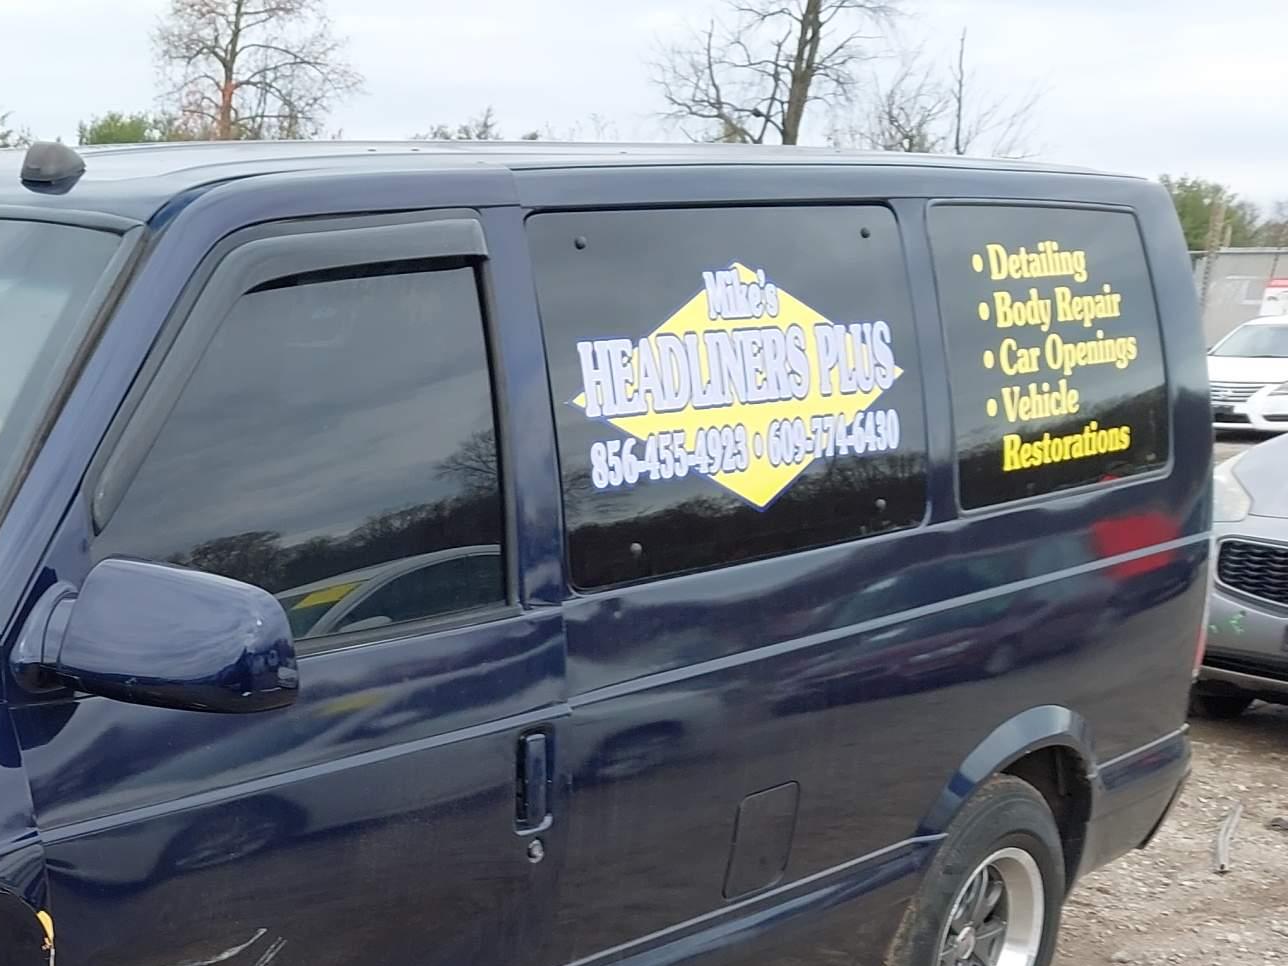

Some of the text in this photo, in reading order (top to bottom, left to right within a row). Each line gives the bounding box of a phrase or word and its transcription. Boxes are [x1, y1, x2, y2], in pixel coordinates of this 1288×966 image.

[986, 240, 1088, 283] Detailing
[702, 268, 779, 320] Mike's
[992, 283, 1122, 332] Body Repair
[577, 321, 896, 417] HEADLINERS PLUS
[999, 329, 1138, 376] Car Openings
[1001, 379, 1080, 423] Vehicle
[590, 408, 900, 488] 856-455-4923 609-774-6430
[1003, 420, 1131, 472] Restorations
